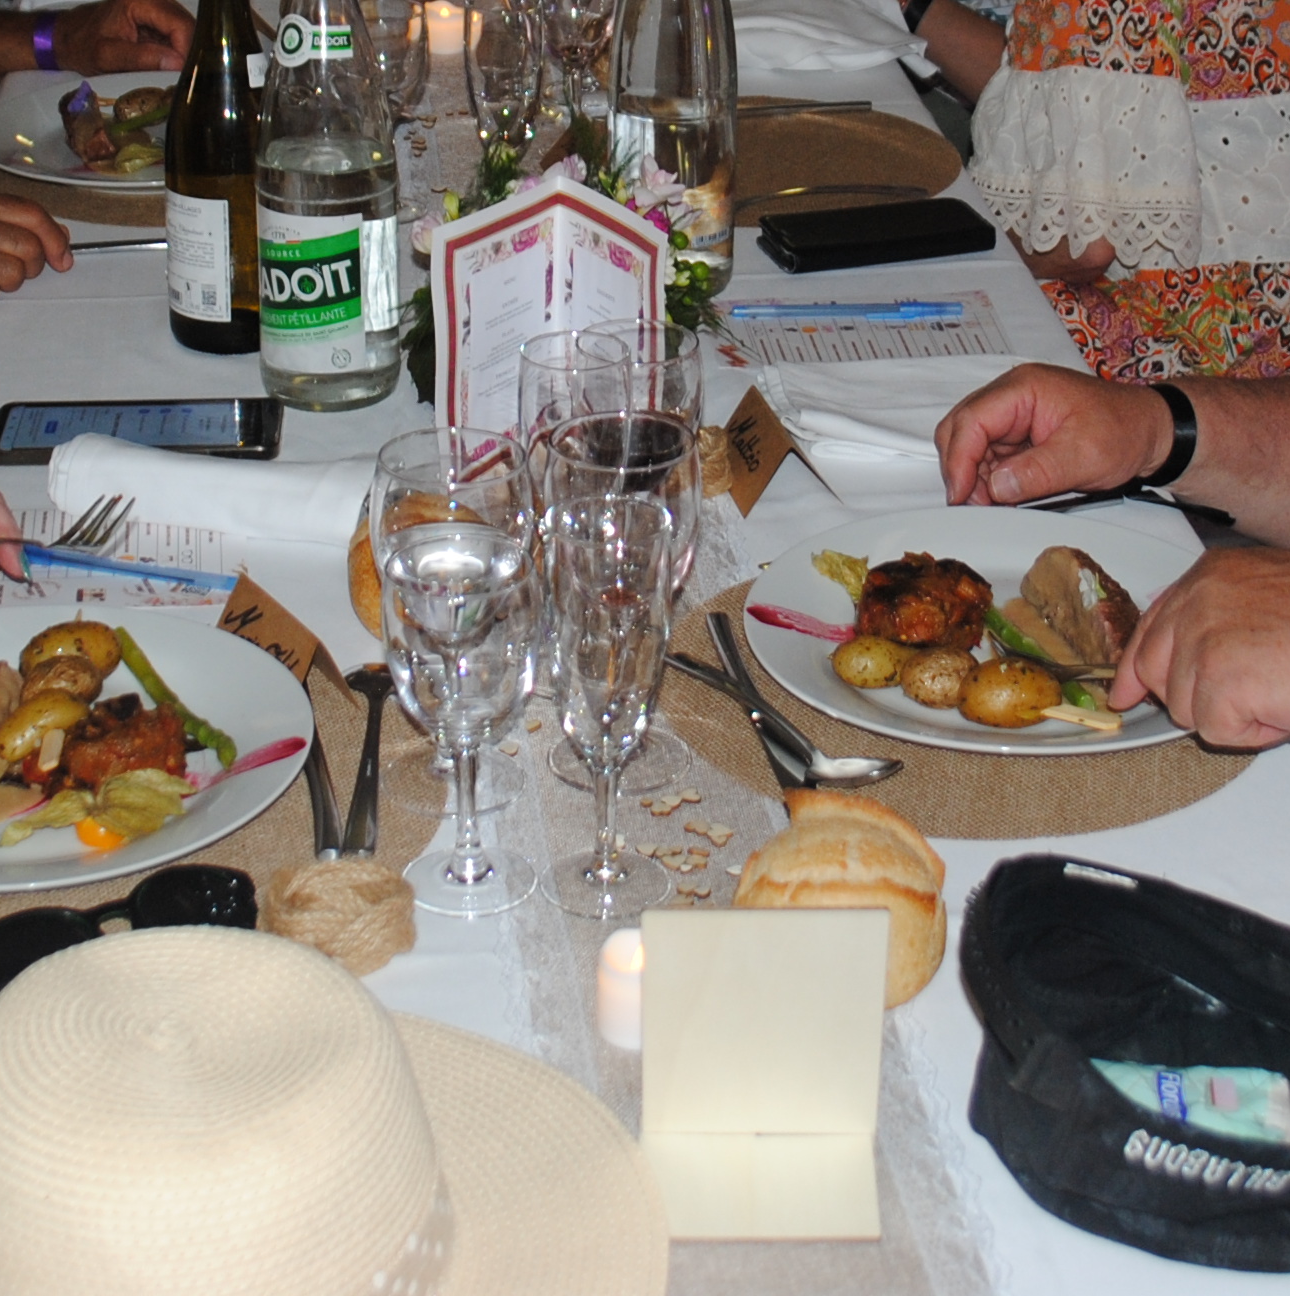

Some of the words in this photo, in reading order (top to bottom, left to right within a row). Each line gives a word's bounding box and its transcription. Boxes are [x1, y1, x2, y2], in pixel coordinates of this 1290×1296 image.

[266, 248, 301, 258] SOURCE
[261, 259, 352, 302] ADOIT
[289, 306, 346, 325] PÉTILLANTE
